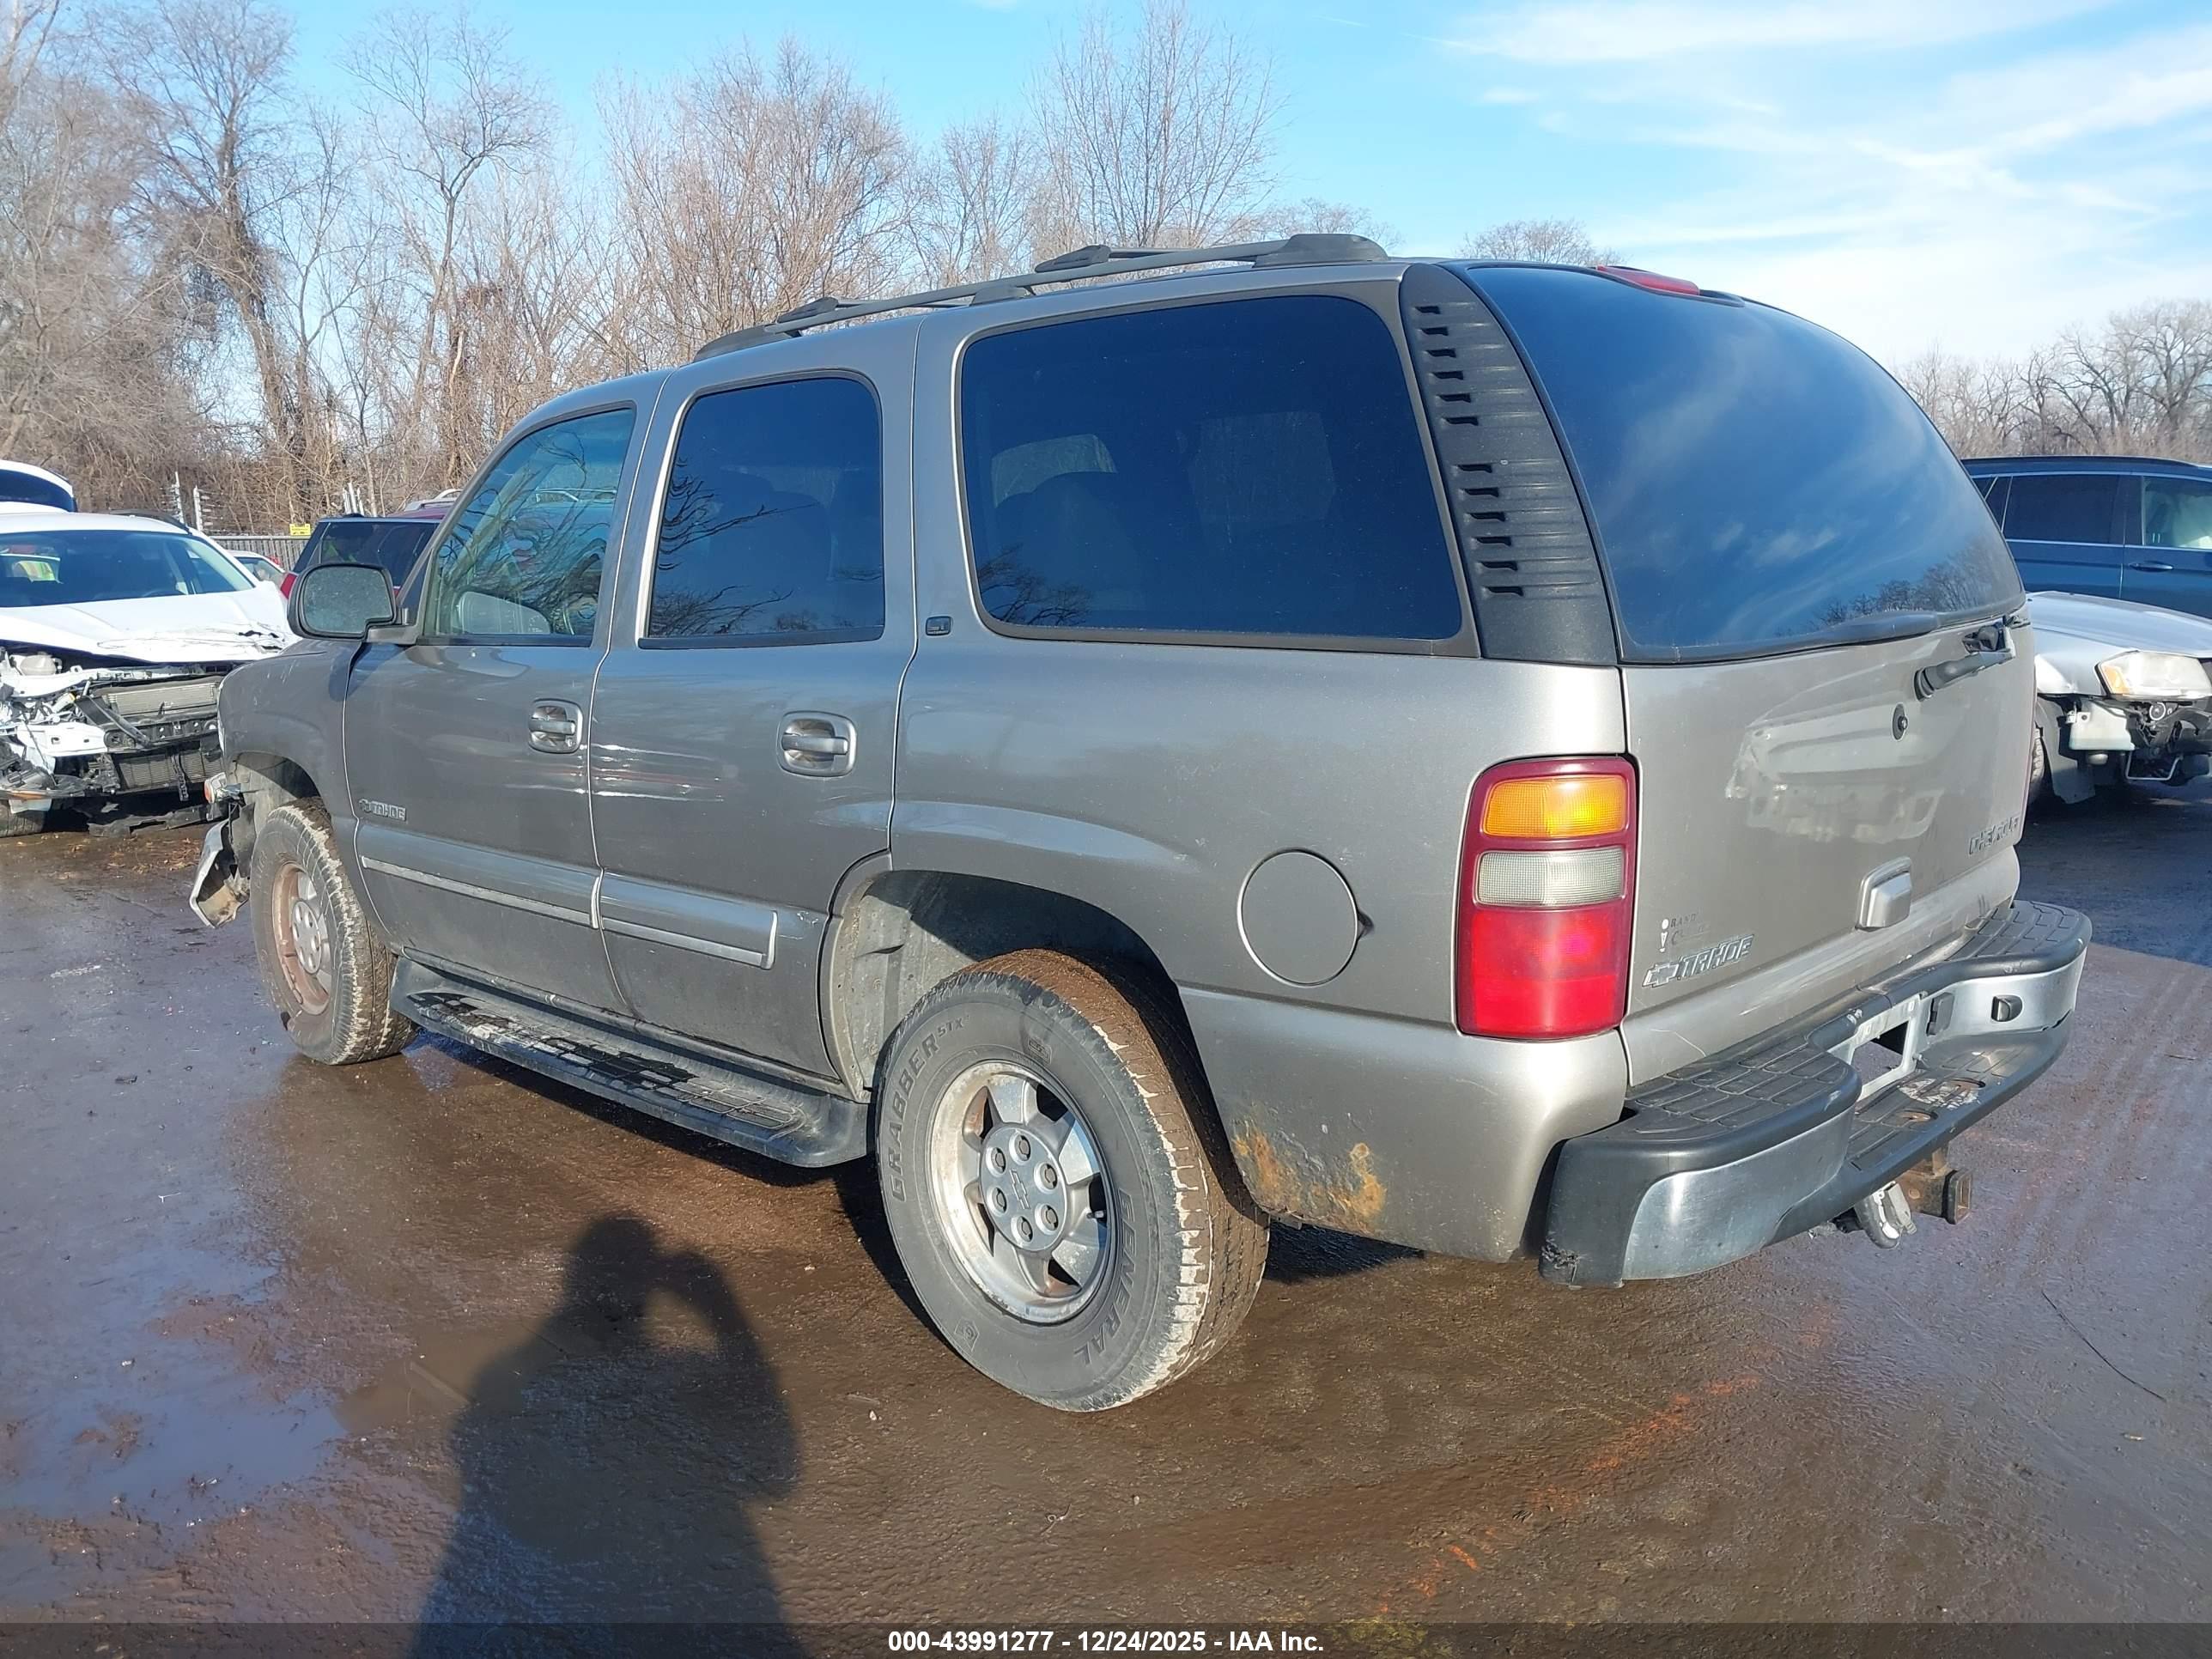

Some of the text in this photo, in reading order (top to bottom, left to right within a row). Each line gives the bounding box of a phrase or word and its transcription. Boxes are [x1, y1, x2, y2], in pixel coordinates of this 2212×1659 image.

[1680, 935, 1753, 978] TAHOE
[886, 1033, 941, 1202] GRABBER
[1073, 1188, 1133, 1365] GENERAL
